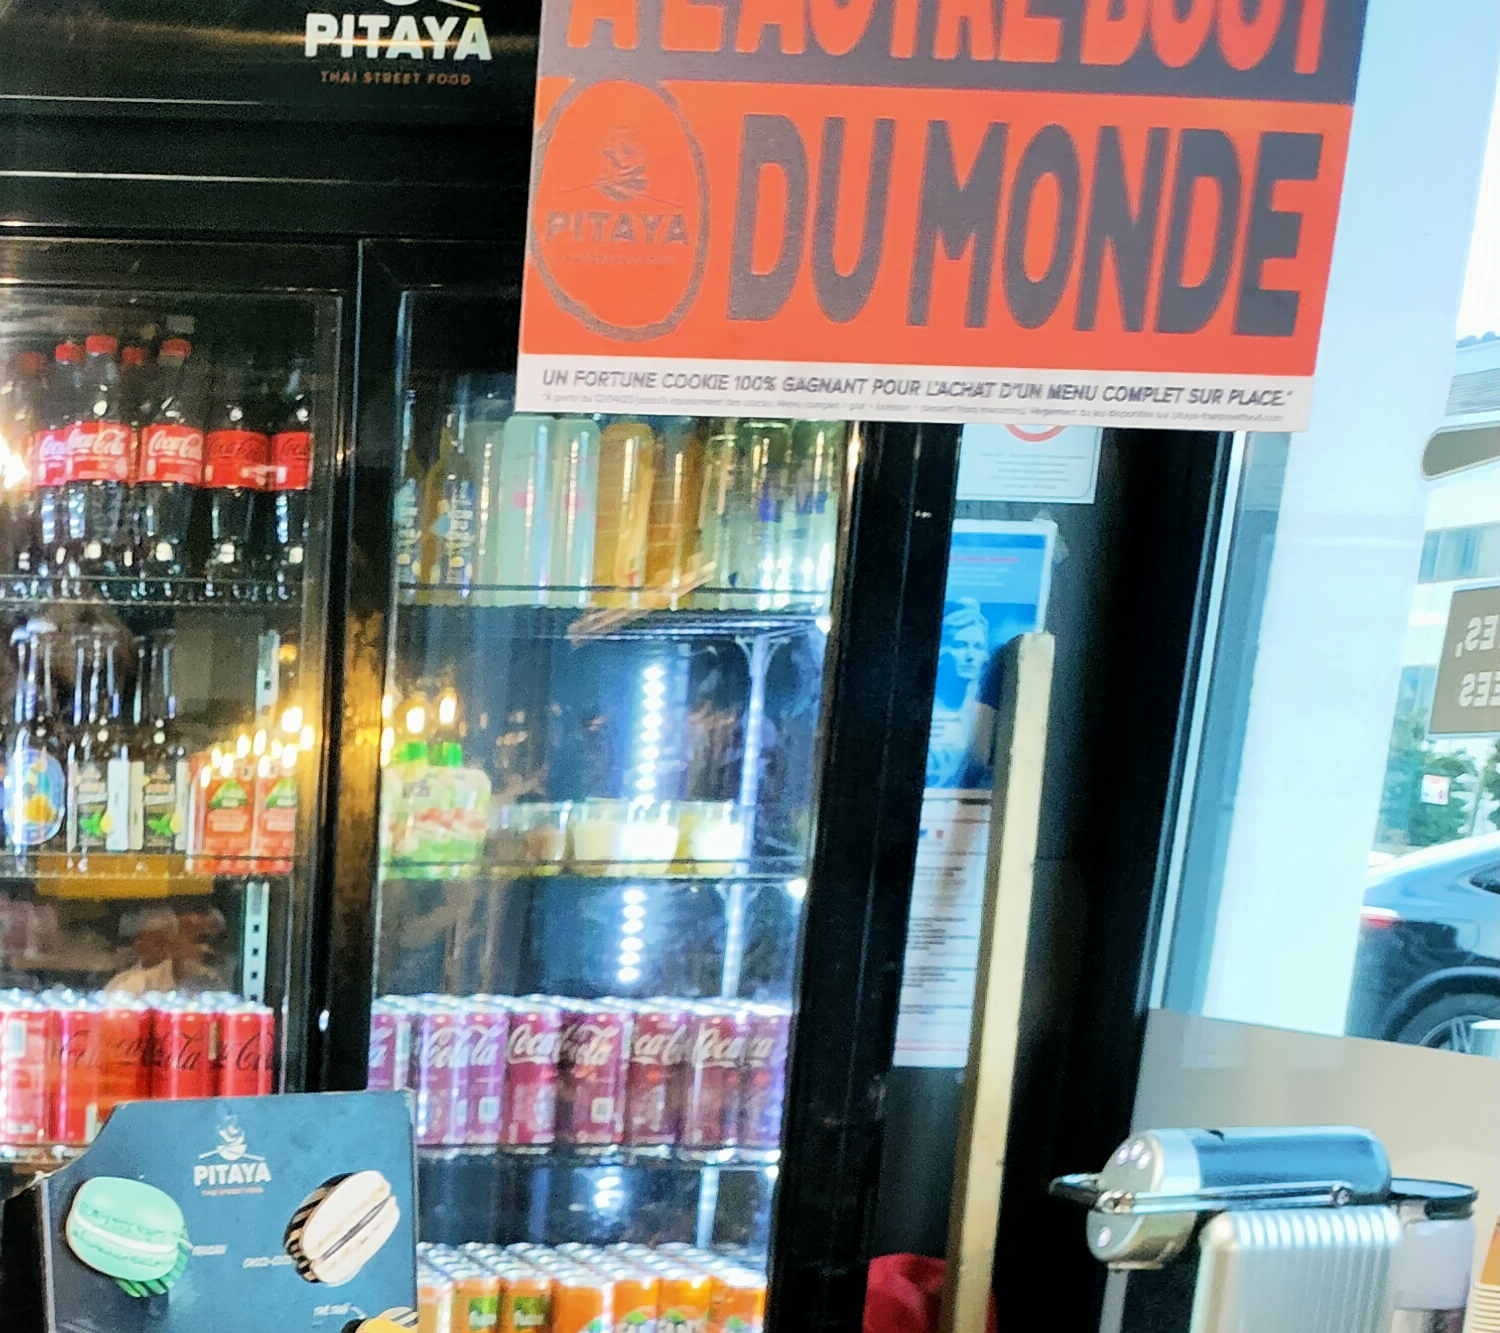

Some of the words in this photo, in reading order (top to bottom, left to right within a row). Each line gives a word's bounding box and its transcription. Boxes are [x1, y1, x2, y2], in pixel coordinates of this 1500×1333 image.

[304, 13, 493, 61] PITAYA
[427, 74, 472, 86] FOOD
[546, 211, 690, 246] PITAYA
[726, 113, 896, 324] DU
[907, 120, 1323, 338] MONDE
[542, 369, 569, 387] UN
[573, 370, 658, 388] FORTUNE
[661, 372, 731, 390] COOKIE
[734, 374, 778, 392] 100%
[781, 376, 869, 394] GAGNANT
[872, 378, 922, 397] POUR
[1046, 383, 1099, 401] MENU
[1102, 385, 1186, 403] COMPLET
[1188, 387, 1224, 405] SUR
[193, 1162, 272, 1187] PITAYA
